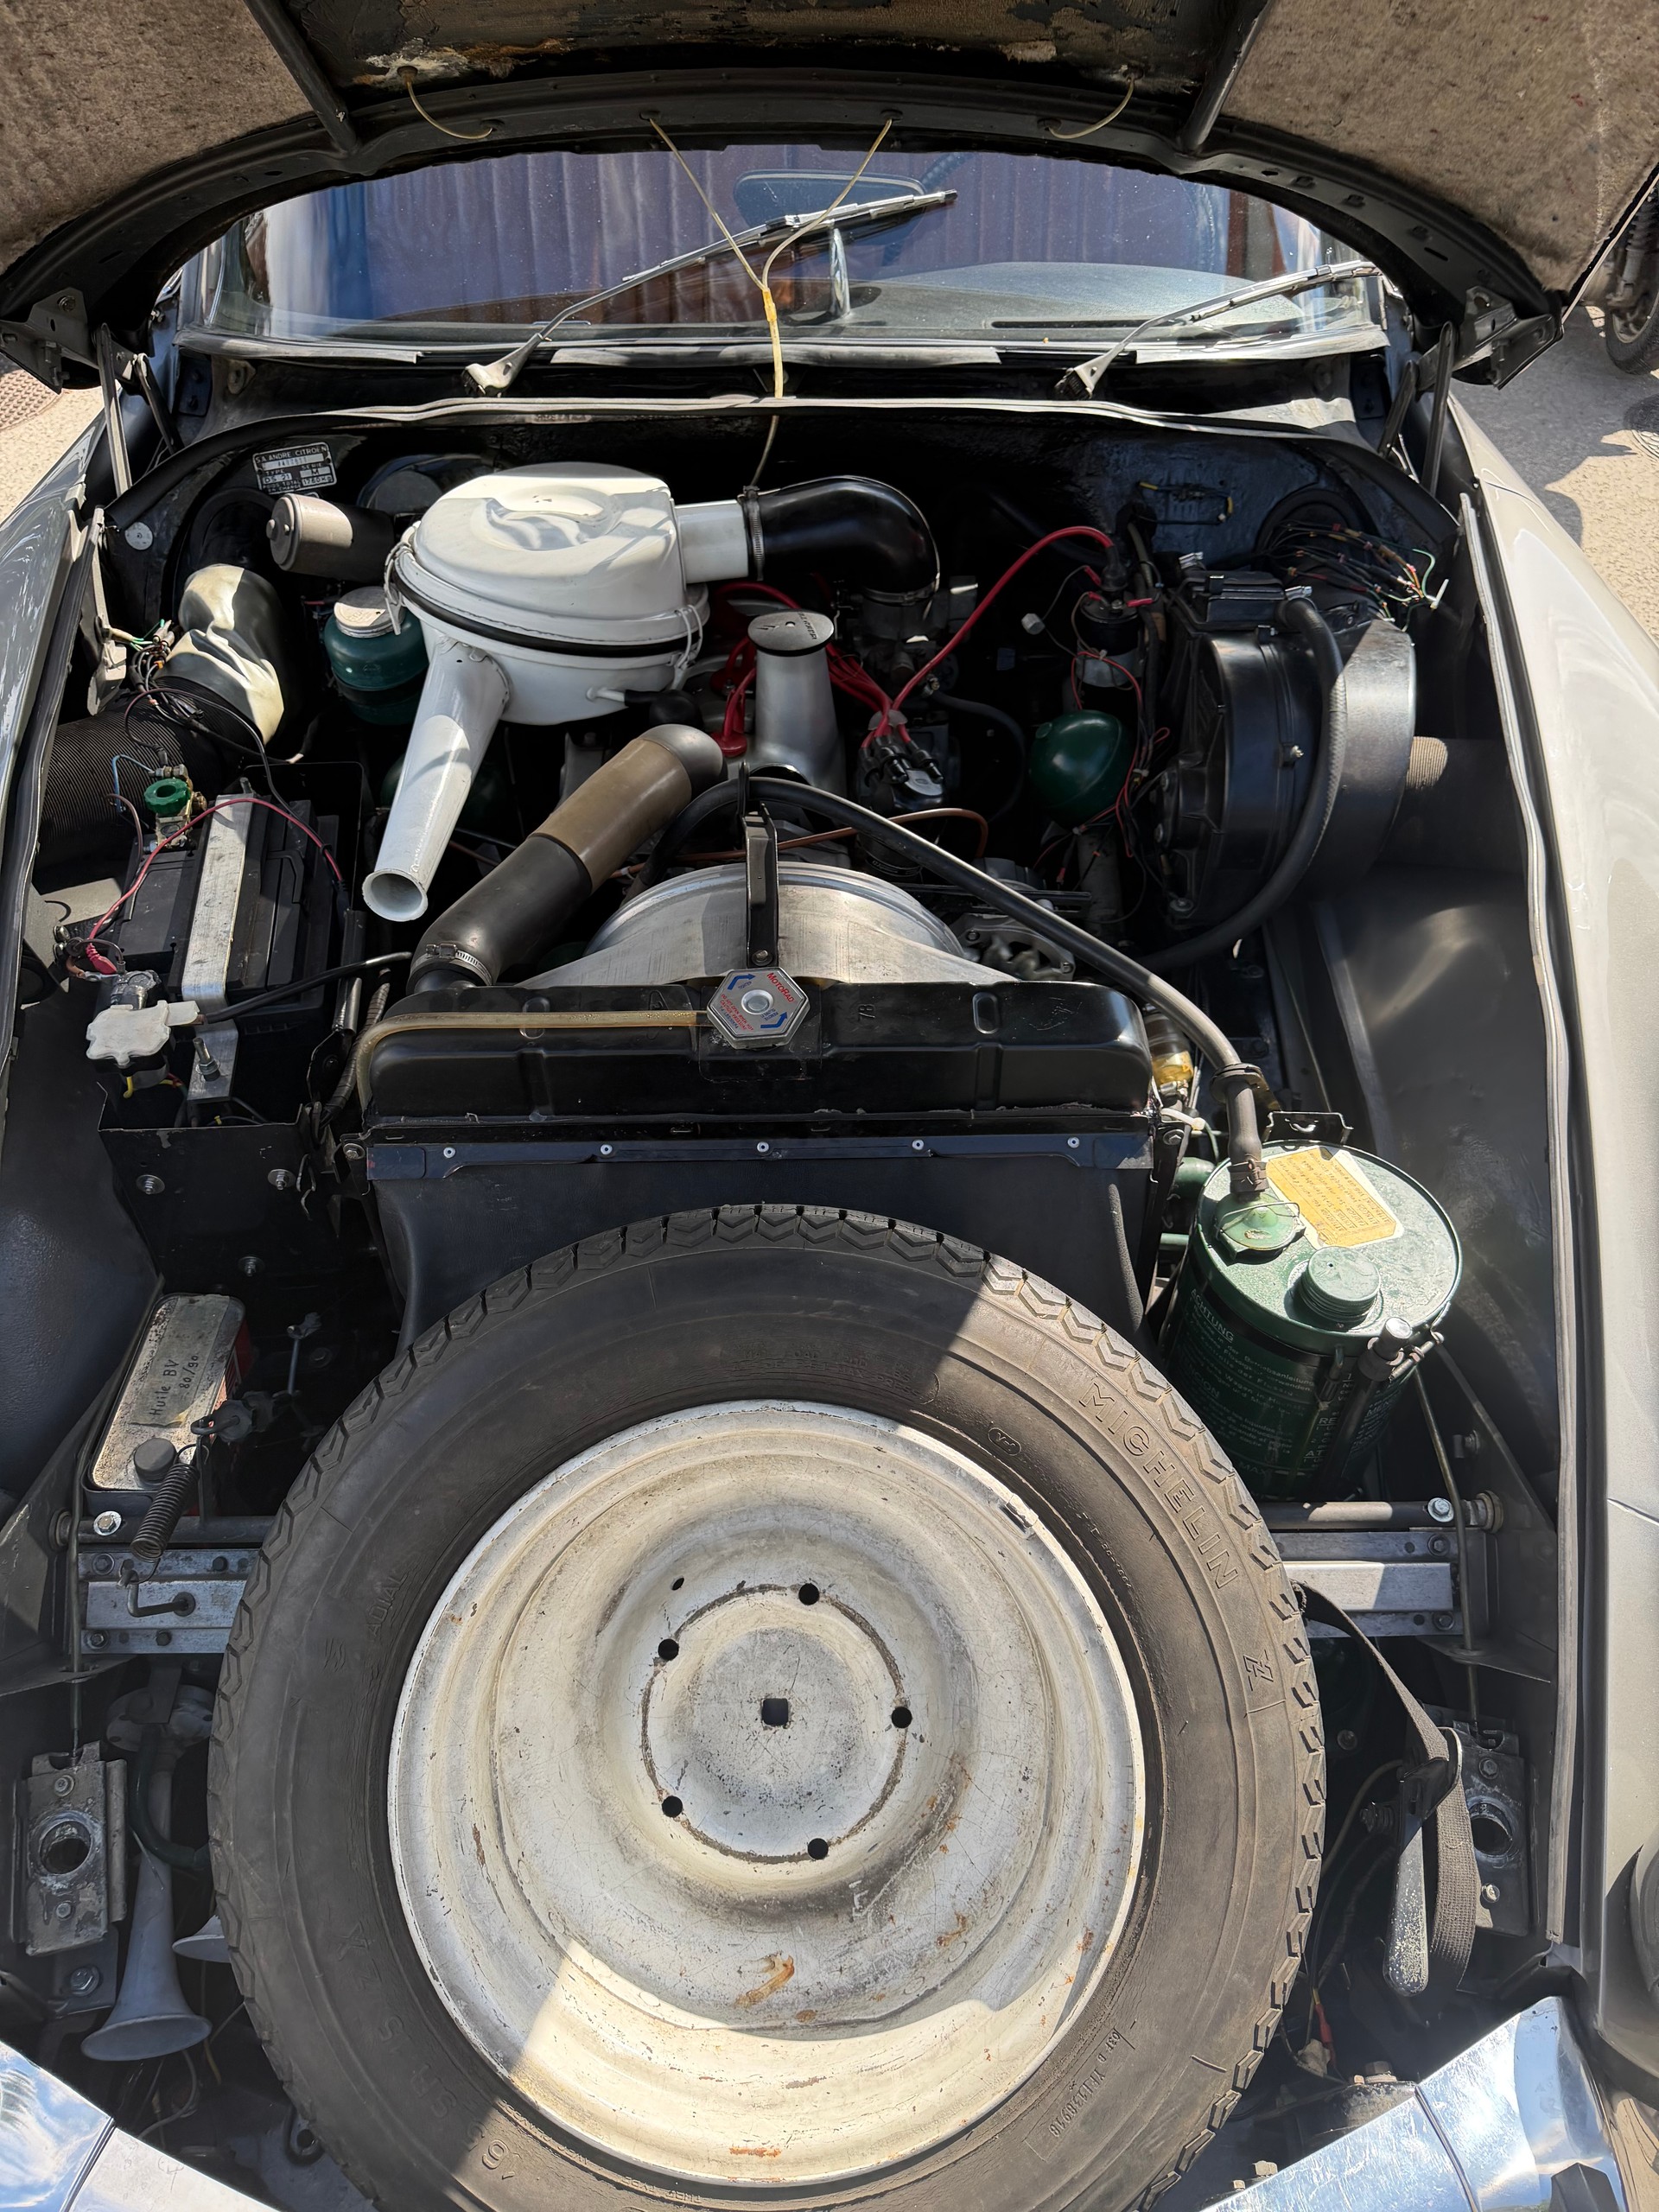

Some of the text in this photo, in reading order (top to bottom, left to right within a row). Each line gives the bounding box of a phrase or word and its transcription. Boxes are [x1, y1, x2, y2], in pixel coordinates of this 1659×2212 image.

[264, 475, 276, 484] DS
[766, 972, 794, 1002] MOTORAD
[1191, 1288, 1235, 1342] ACHTUNG
[149, 1358, 180, 1416] Huile BV
[1079, 1382, 1239, 1590] MICHELIN
